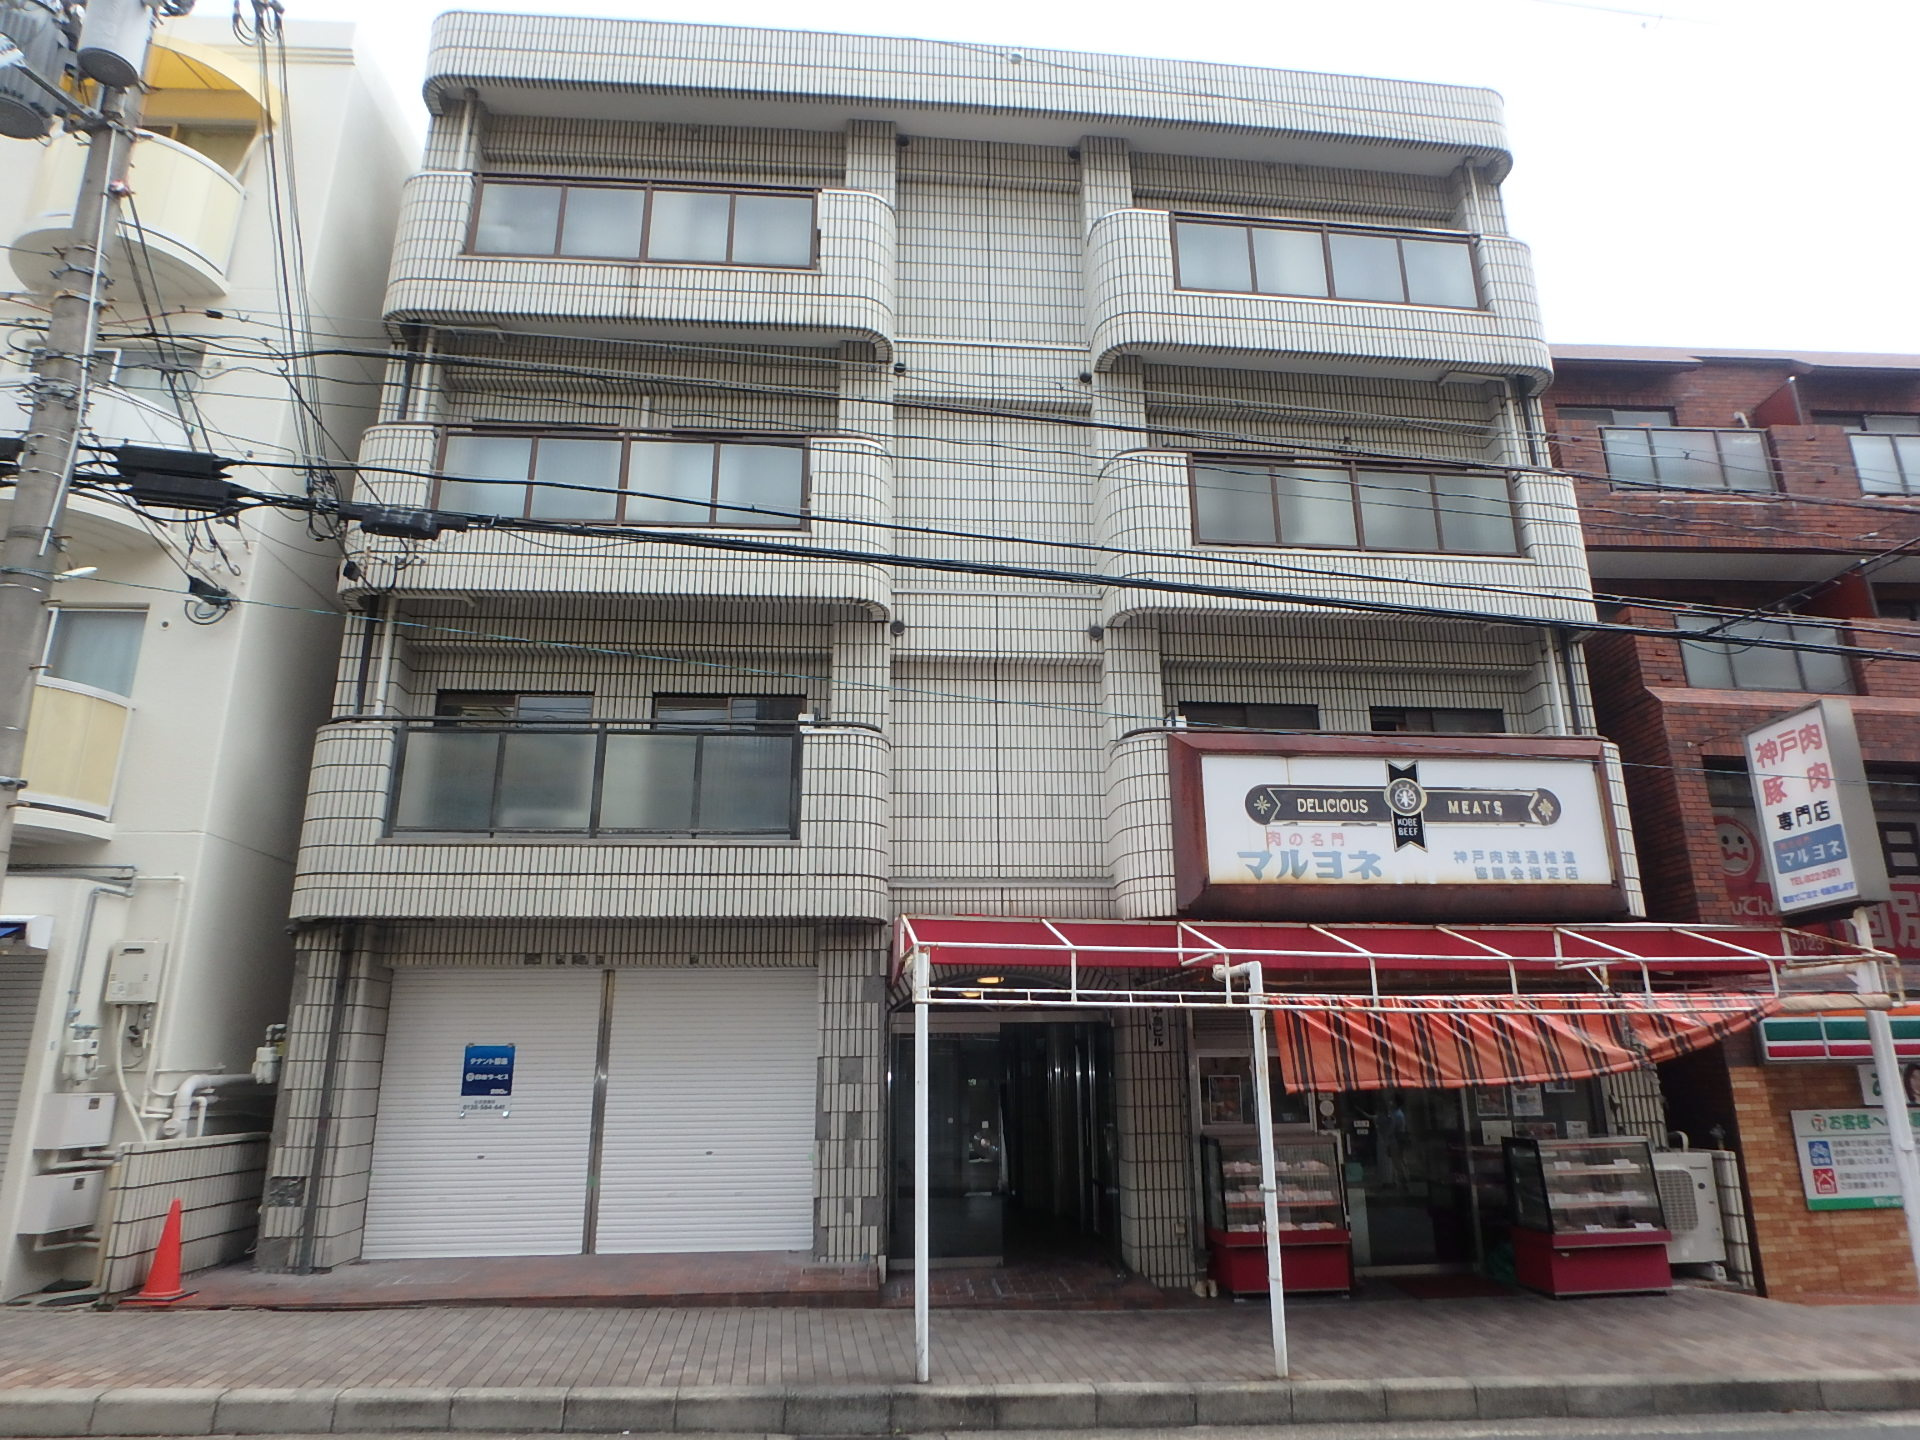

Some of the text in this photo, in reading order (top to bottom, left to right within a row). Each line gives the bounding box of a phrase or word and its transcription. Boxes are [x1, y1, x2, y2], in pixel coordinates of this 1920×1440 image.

[1755, 723, 1823, 768] 神戸肉
[1763, 761, 1831, 806] 豚肉
[1297, 798, 1503, 816] DELICIOUS MEATS
[1776, 799, 1831, 831] 専門店
[1397, 817, 1418, 827] KOBE
[1398, 827, 1418, 836] BEEF
[1267, 830, 1345, 847] 肉の名門
[1453, 849, 1576, 865] 神戸肉流通推進
[1780, 840, 1842, 866] マルヨネ
[1237, 849, 1383, 880] マルヨネ
